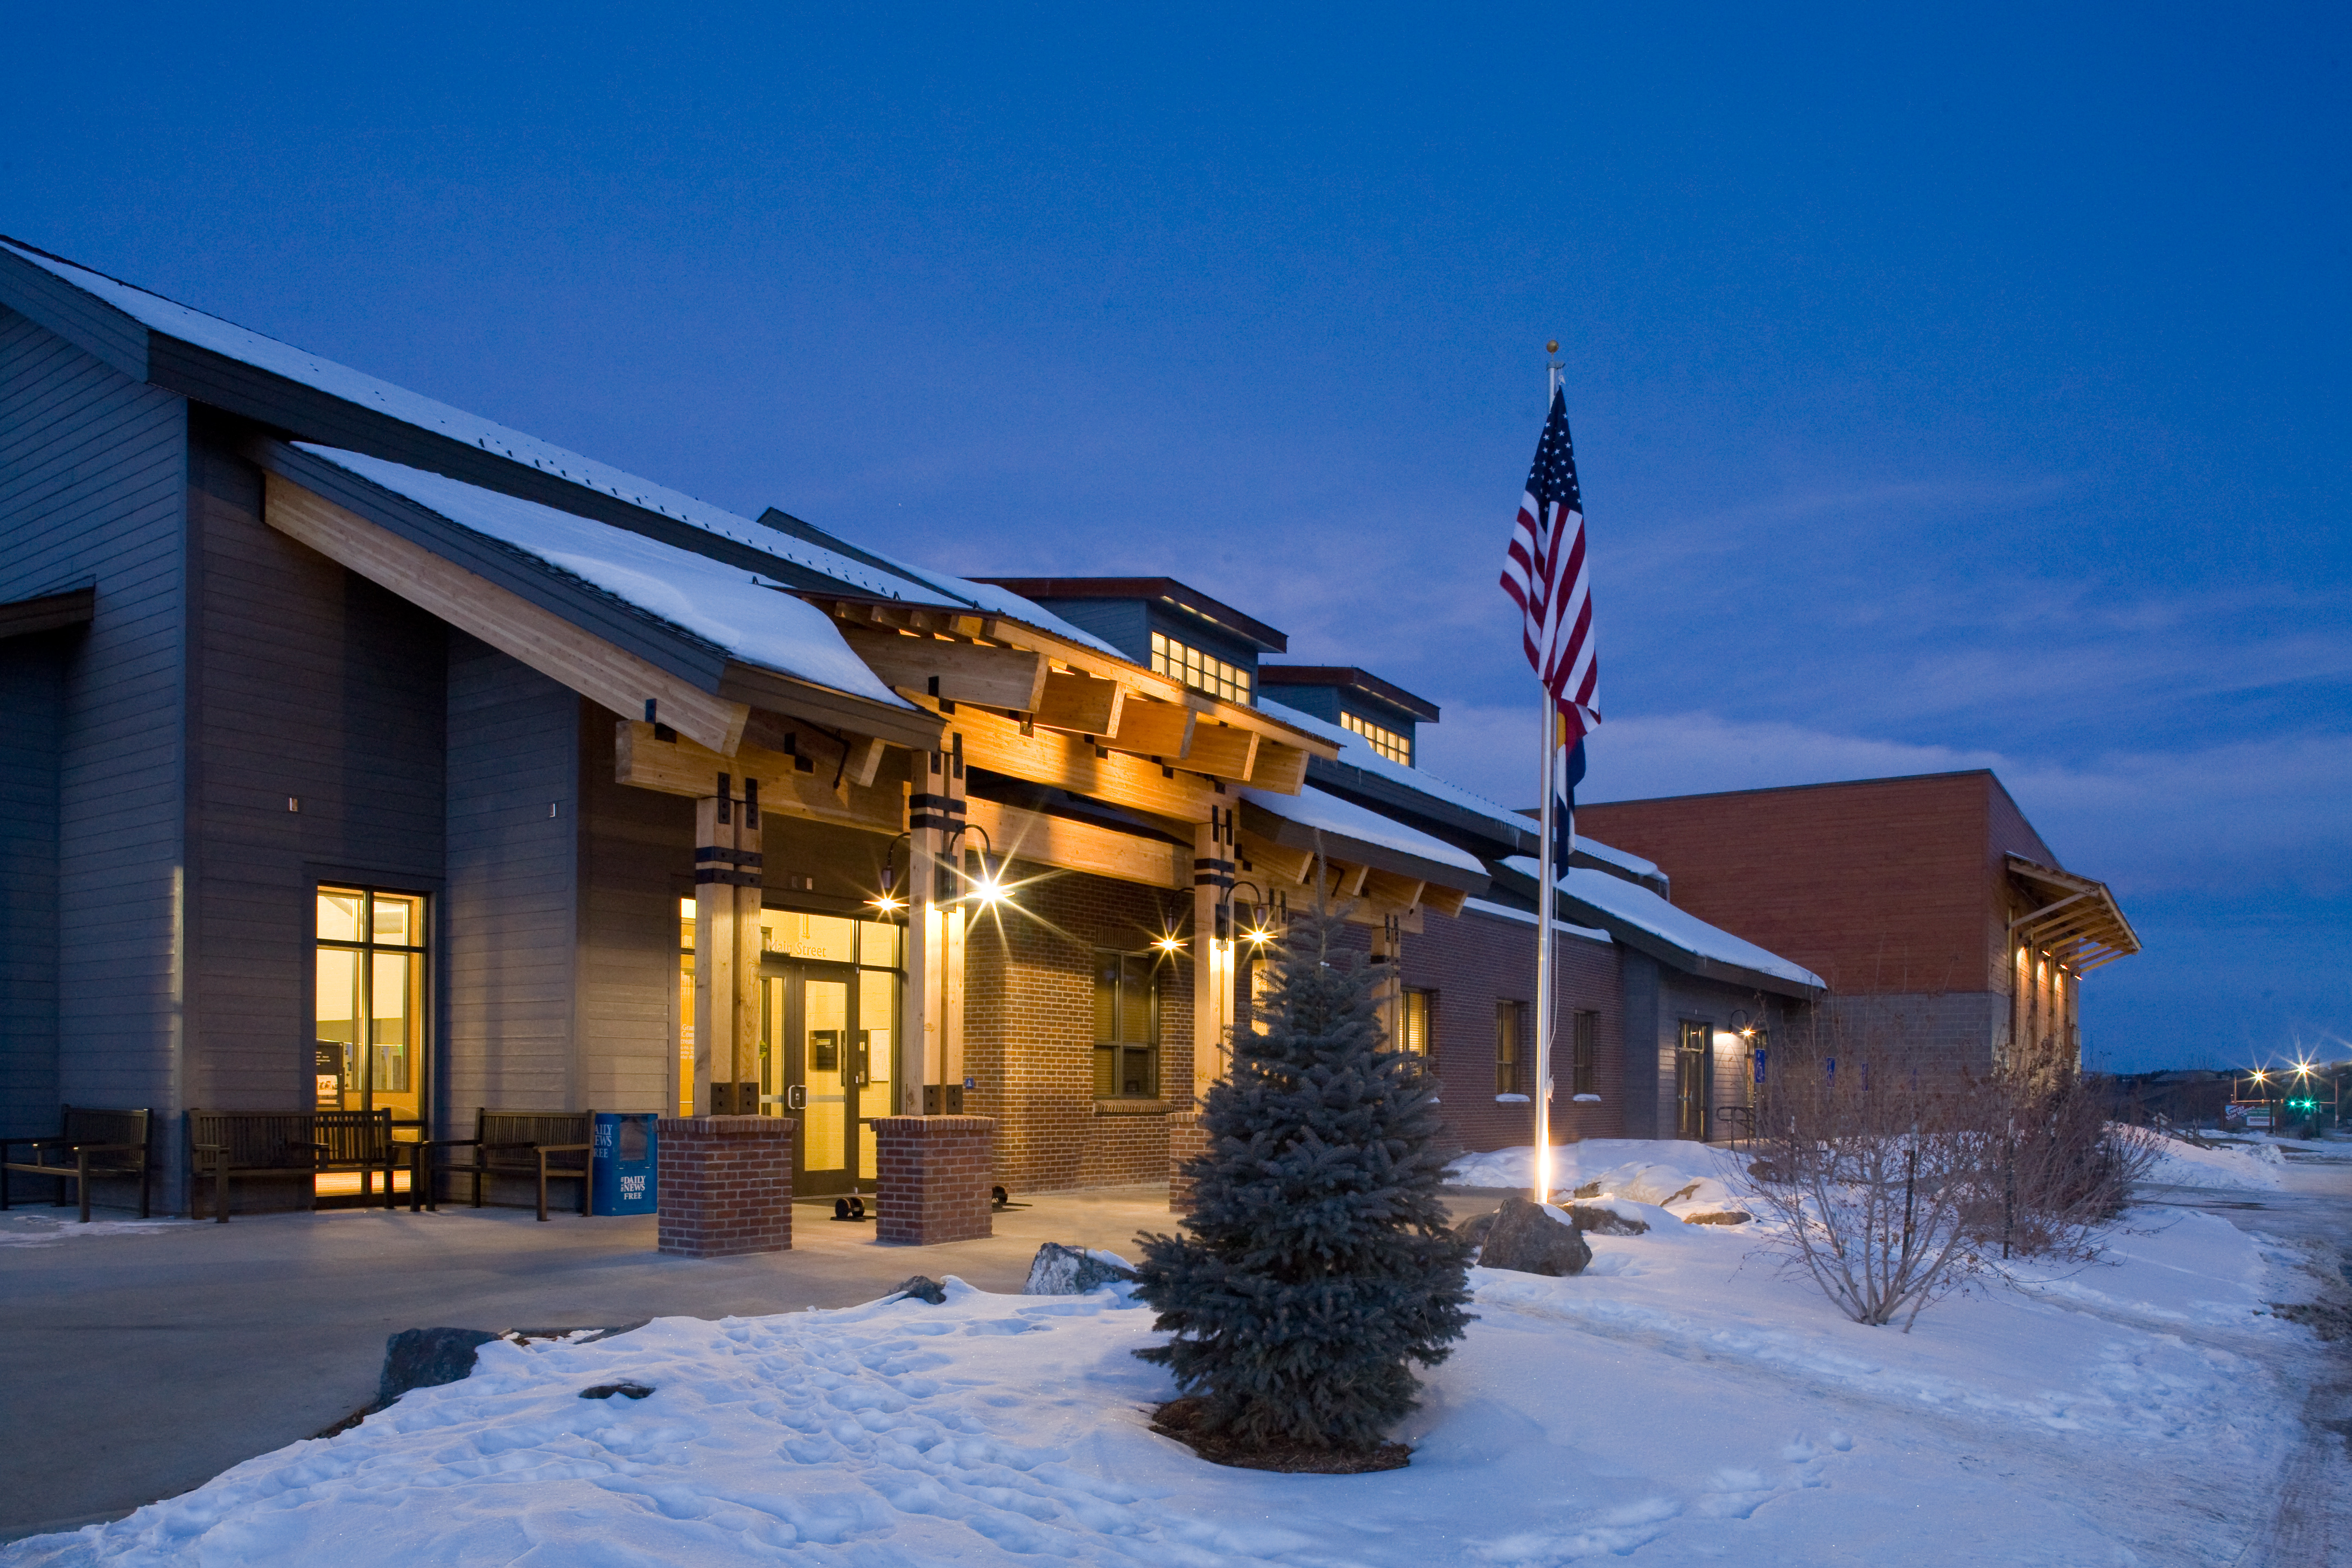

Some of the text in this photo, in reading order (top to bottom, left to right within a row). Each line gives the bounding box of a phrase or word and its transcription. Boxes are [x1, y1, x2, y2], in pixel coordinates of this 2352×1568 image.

[765, 938, 827, 957] Main Street
[2226, 1105, 2244, 1116] Energy
[2237, 1105, 2256, 1116] Homes
[594, 1124, 613, 1135] AILY
[594, 1135, 612, 1146] EWS
[593, 1148, 608, 1158] REE
[624, 1175, 646, 1184] DAILY
[624, 1183, 646, 1192] NEWS
